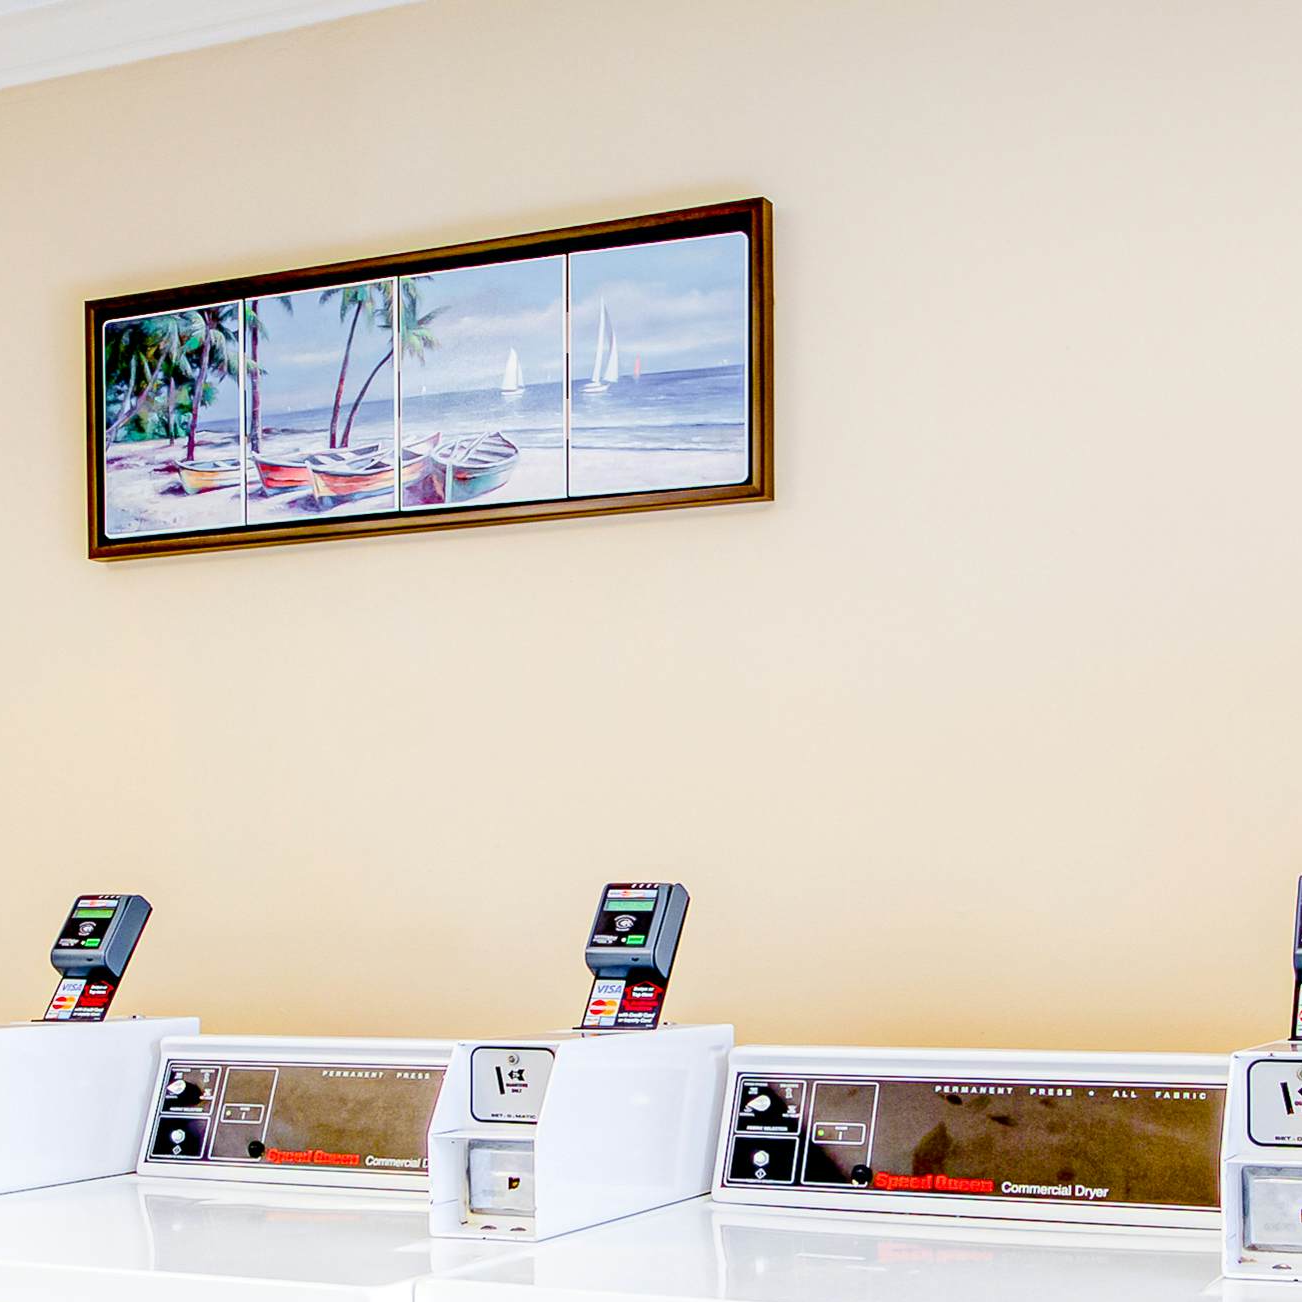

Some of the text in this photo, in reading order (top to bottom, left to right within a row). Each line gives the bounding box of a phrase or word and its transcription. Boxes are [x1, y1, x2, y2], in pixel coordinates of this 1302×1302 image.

[597, 984, 622, 994] VISA
[322, 1070, 431, 1080] PERMANENT PRESS
[934, 1085, 1207, 1100] PERMANENT PRESS ALL FABRIC
[365, 1155, 421, 1168] Commercial
[874, 1171, 1110, 1200] Speed Queen Commercial Dryer
